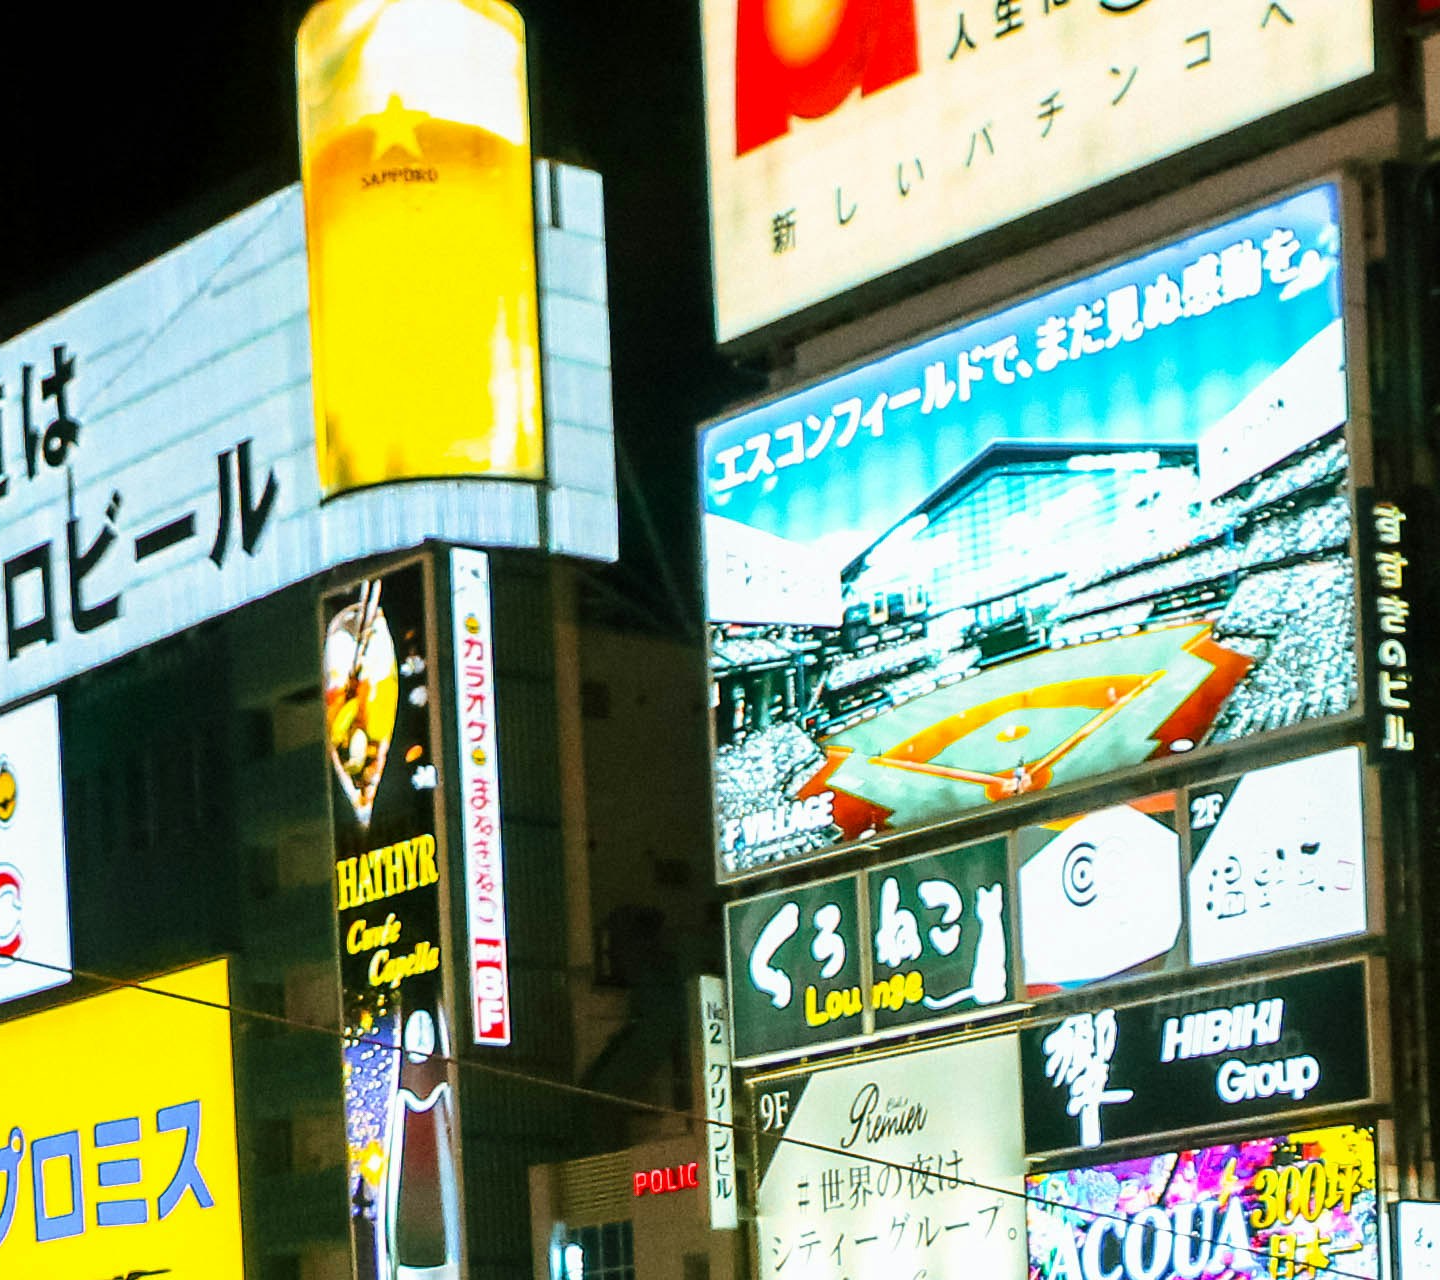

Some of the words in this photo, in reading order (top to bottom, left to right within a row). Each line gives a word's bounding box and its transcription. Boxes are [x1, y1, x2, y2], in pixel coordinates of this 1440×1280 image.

[1373, 502, 1414, 751] すすきのビル
[1190, 793, 1224, 830] 2F
[337, 834, 439, 911] HATHYR
[369, 941, 439, 989] Capella
[749, 878, 962, 1009] くろねこ
[805, 971, 925, 1027] Lounge
[1161, 998, 1285, 1062] HIBIKI
[761, 1090, 790, 1132] 9F
[1216, 1056, 1320, 1106] Group
[1250, 1158, 1363, 1230] 300坪
